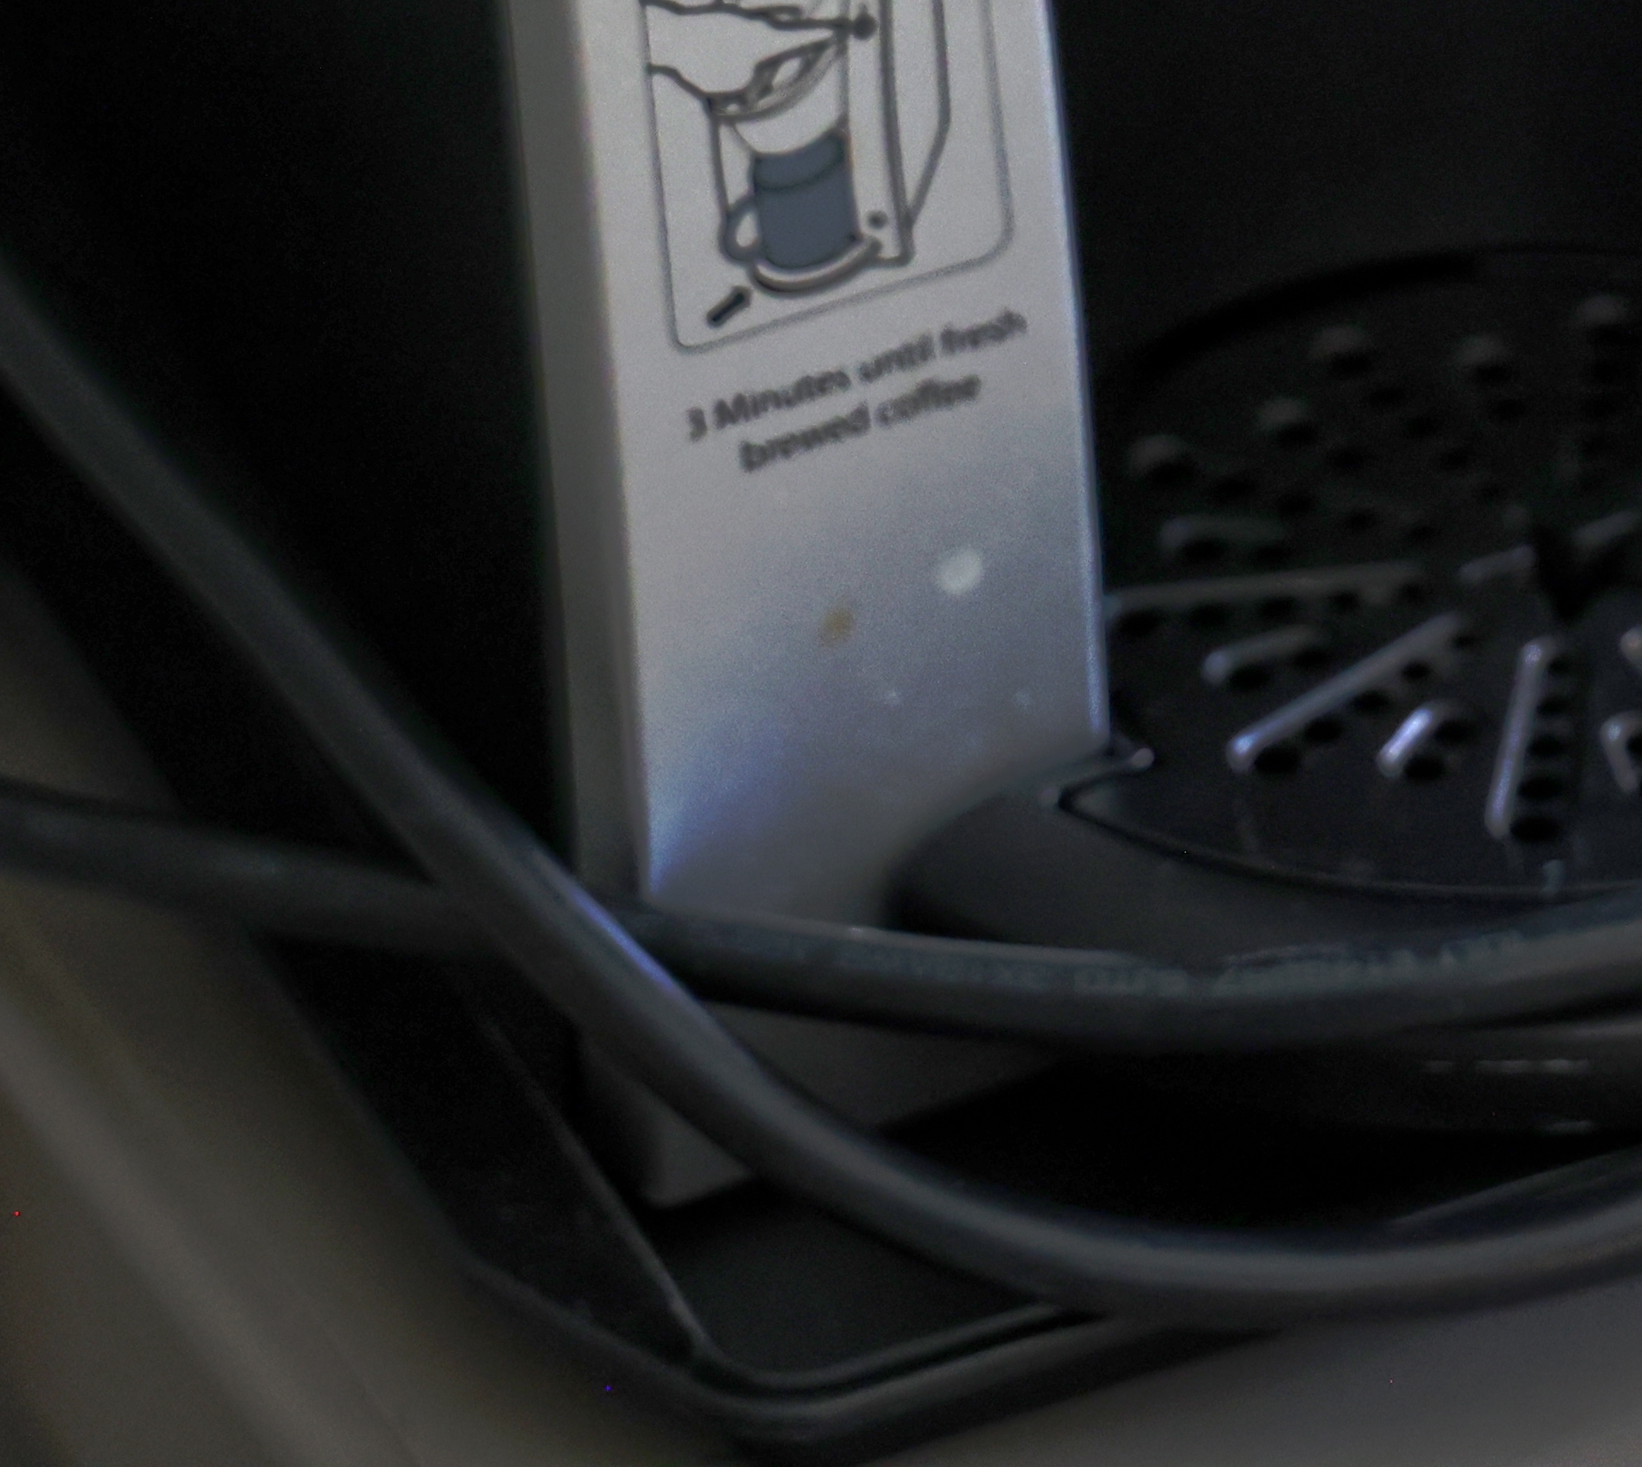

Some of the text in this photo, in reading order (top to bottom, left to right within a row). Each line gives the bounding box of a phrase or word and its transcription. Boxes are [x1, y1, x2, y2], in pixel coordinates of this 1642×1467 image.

[712, 368, 852, 430] Minutes
[858, 331, 935, 384] until
[939, 308, 1028, 355] fresh
[738, 372, 983, 473] brewed coffee
